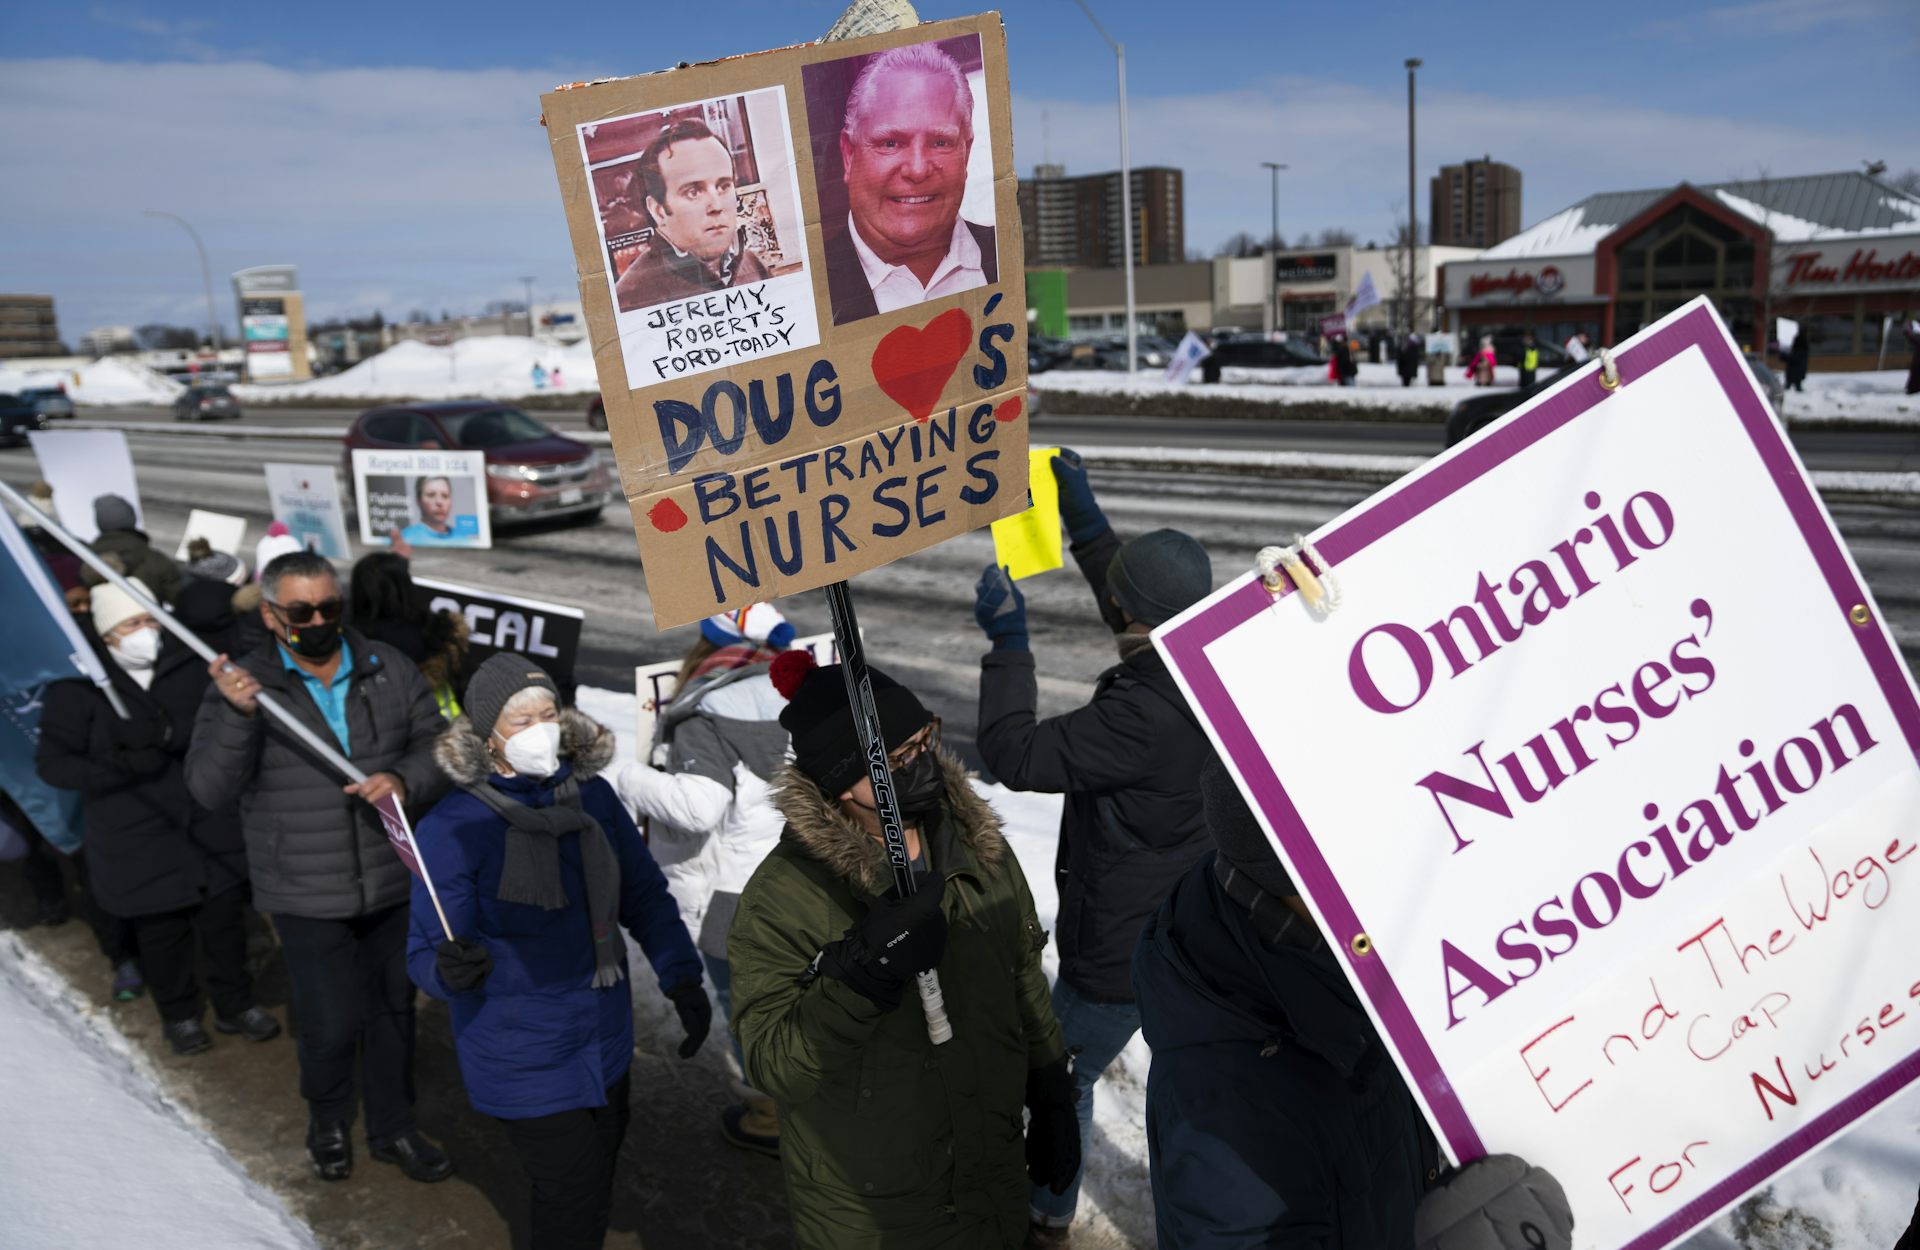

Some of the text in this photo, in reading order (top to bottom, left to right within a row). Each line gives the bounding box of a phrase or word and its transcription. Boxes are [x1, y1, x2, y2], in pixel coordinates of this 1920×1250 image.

[647, 283, 766, 329] JEREMY
[652, 322, 796, 379] FORD-TOADY
[666, 303, 786, 351] ROBERT'S
[653, 359, 842, 475] DOUG
[692, 403, 996, 525] BETRAYING
[705, 450, 1000, 603] NURSES
[1348, 491, 1675, 715] Ontario
[1415, 598, 1716, 855] Nurses'
[866, 737, 907, 868] VECTOR
[1441, 703, 1880, 1031] Association
[887, 930, 909, 948] HEAD
[1520, 838, 1917, 1113] End The Wage
[1687, 991, 1791, 1061] Cap
[1608, 1141, 1709, 1214] For
